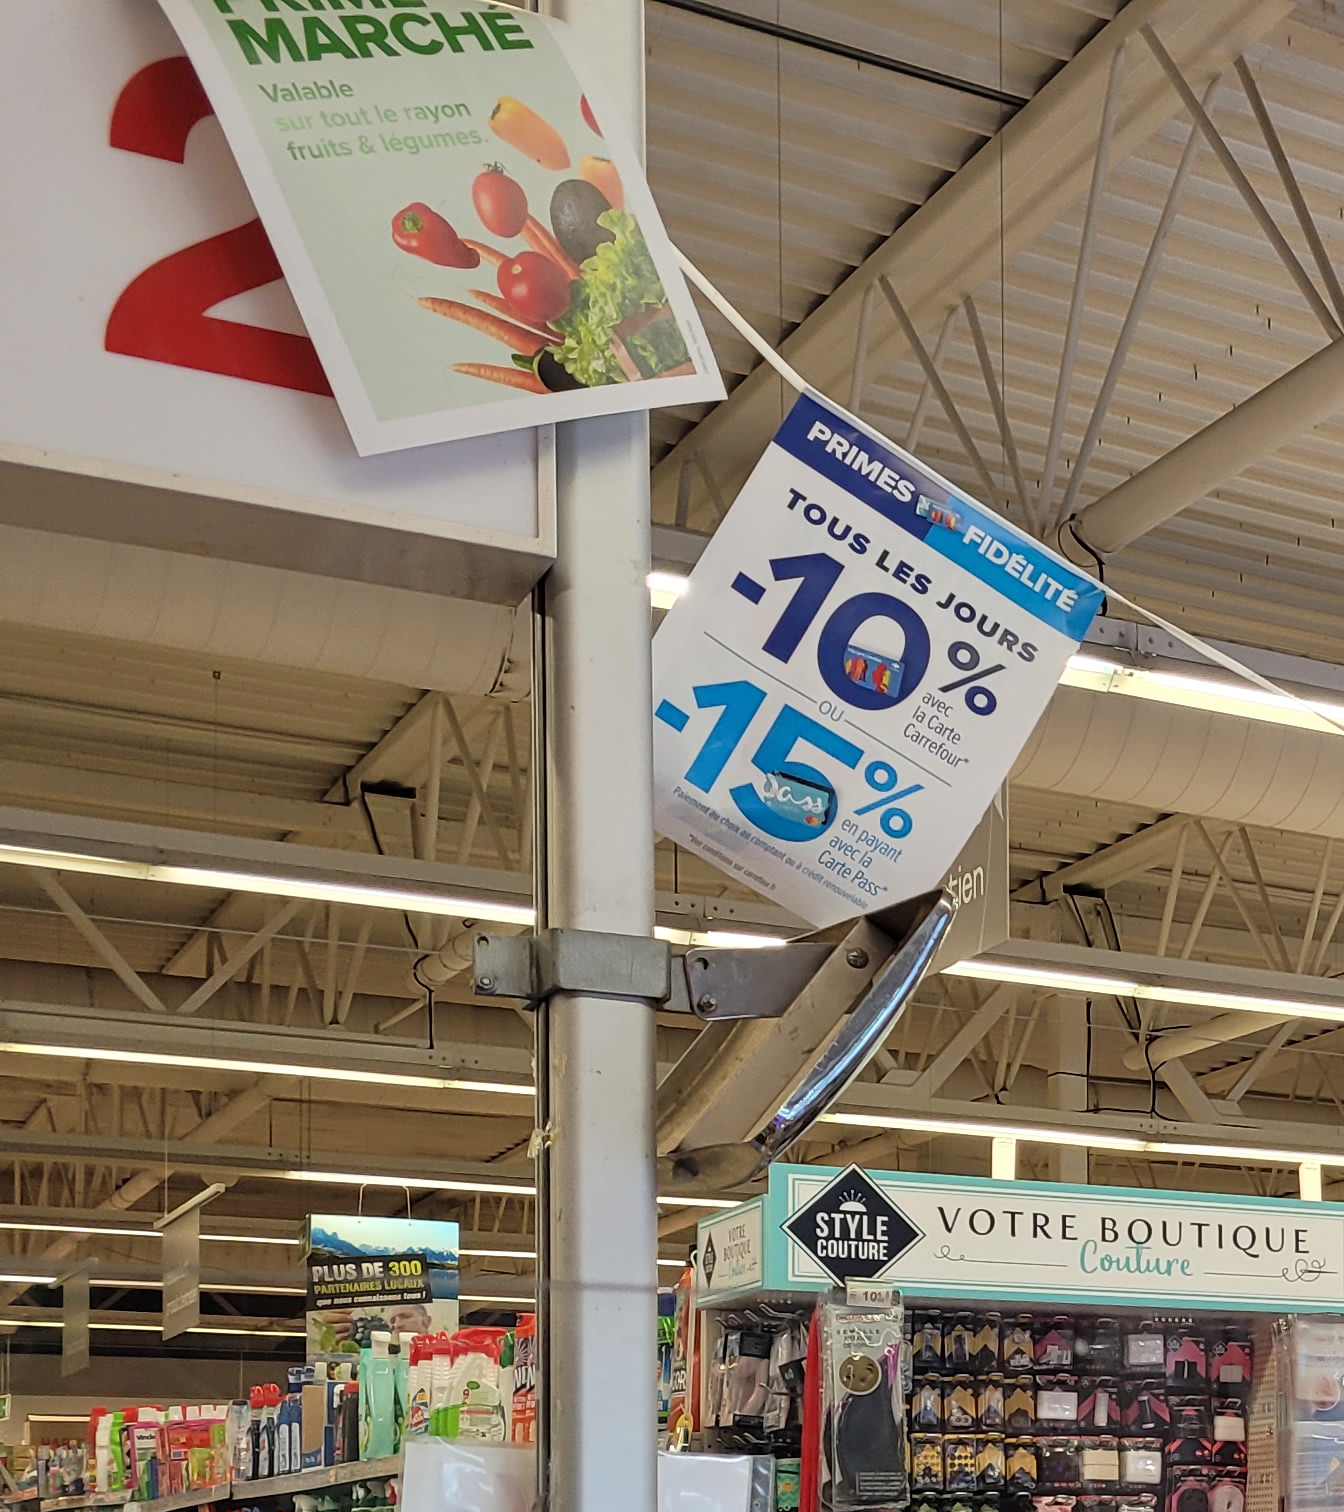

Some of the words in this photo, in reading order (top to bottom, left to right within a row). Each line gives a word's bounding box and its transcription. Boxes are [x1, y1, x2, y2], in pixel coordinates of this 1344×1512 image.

[226, 4, 535, 65] MARCHÉ
[258, 80, 354, 102] Valable
[275, 114, 312, 132] sur
[320, 110, 372, 128] tout
[374, 105, 398, 124] le
[403, 101, 471, 124] rayon
[286, 138, 352, 161] fruits
[358, 134, 377, 154] &
[380, 128, 489, 155] légumes.
[806, 421, 913, 502] PRIMES
[963, 526, 1079, 613] FIDÉLITÉ
[784, 487, 872, 555] TOUS
[876, 549, 933, 596] LES
[936, 591, 1040, 663] JOURS
[818, 701, 844, 723] OU
[921, 691, 954, 718] avec
[912, 704, 924, 724] la
[924, 713, 962, 746] Carte
[829, 835, 860, 859] avec
[861, 853, 874, 868] la
[841, 818, 858, 836] en
[859, 827, 903, 863] payant
[816, 1212, 889, 1241] STYLE
[936, 1206, 1079, 1242] VOTRE
[1101, 1218, 1310, 1258] BOUTIQUE
[817, 1239, 888, 1260] COUTURE
[1078, 1238, 1193, 1278] Couture
[312, 1264, 358, 1282] PLUS
[361, 1262, 384, 1279] DE
[388, 1260, 422, 1276] 300
[314, 1282, 382, 1294] PARTENAIRES
